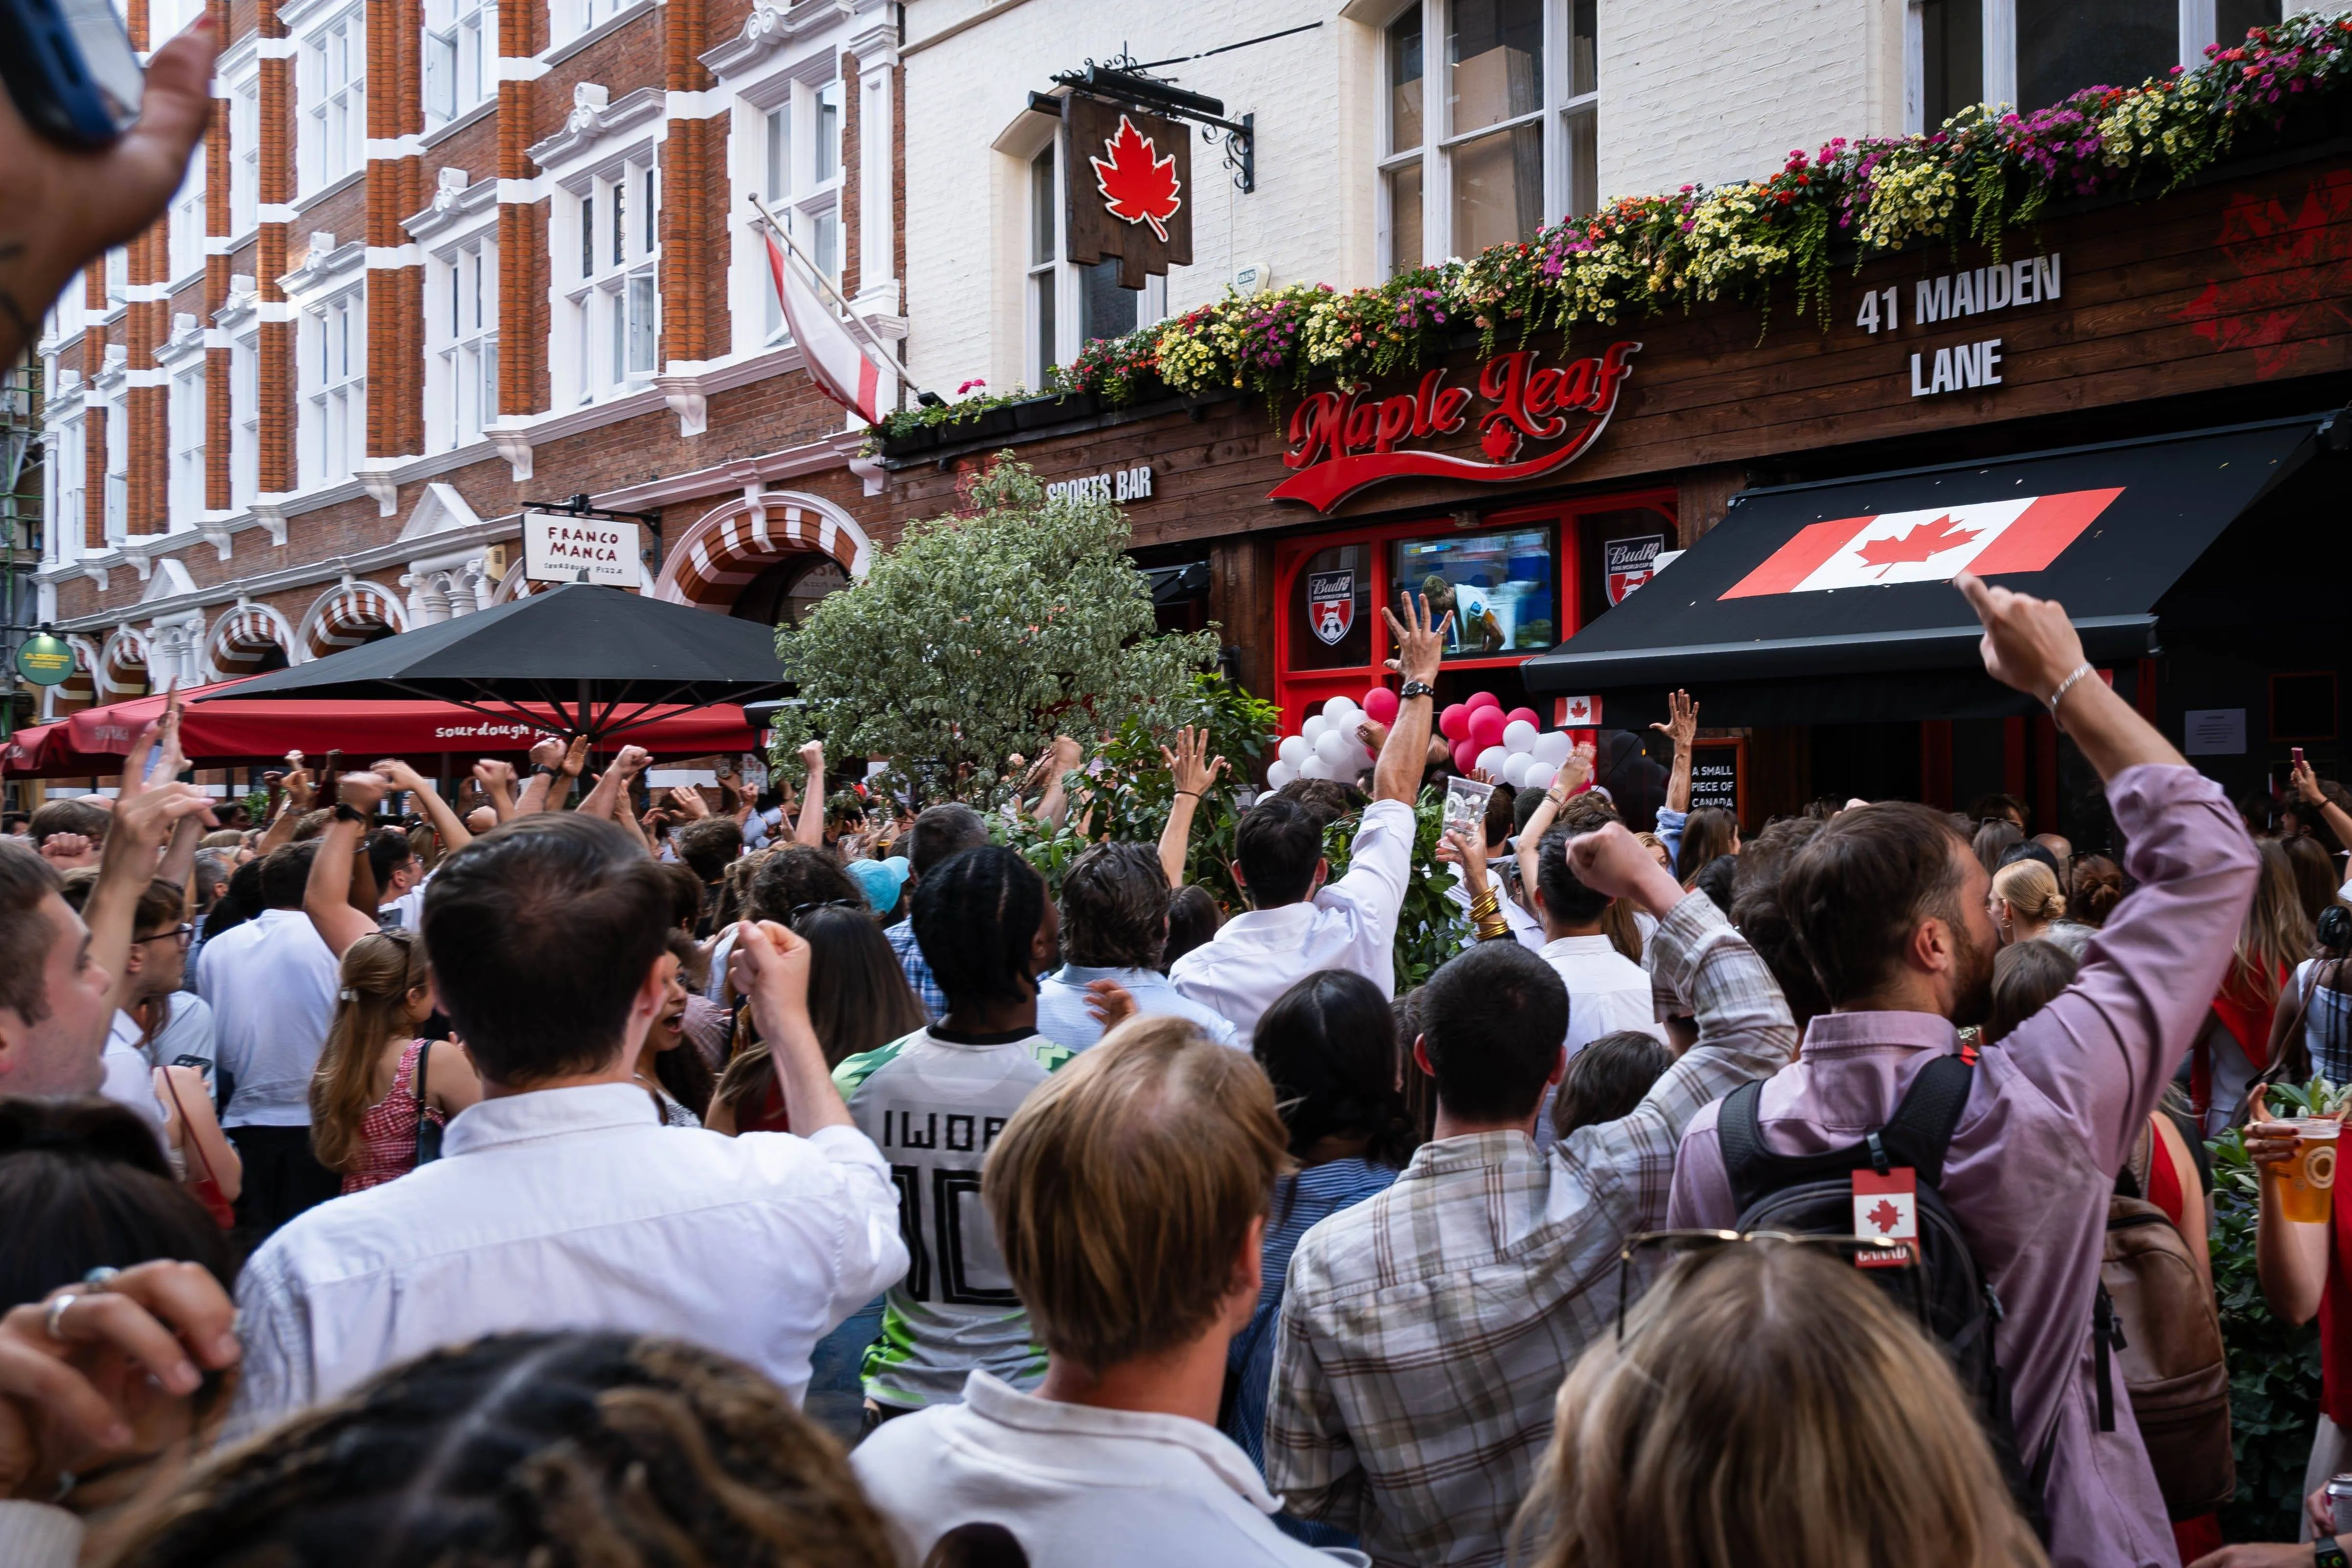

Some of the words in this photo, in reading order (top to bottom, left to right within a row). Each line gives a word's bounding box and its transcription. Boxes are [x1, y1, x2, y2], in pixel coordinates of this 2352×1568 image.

[1857, 286, 1898, 334] 41
[1916, 253, 2061, 325] MAIDEN
[1911, 339, 2002, 397] LANE
[1283, 368, 1472, 470] Maple
[1478, 342, 1643, 439] Leaf
[1116, 466, 1151, 501] BAR
[548, 527, 618, 544] FRANCO
[550, 542, 617, 561] MANCA
[595, 566, 623, 575] PIZZA
[435, 721, 529, 739] sourdough
[1692, 766, 1699, 776] A
[1701, 765, 1734, 776] SMALL
[1691, 782, 1718, 791] PIECE
[1720, 782, 1734, 791] OF
[1692, 798, 1734, 807] CANADA
